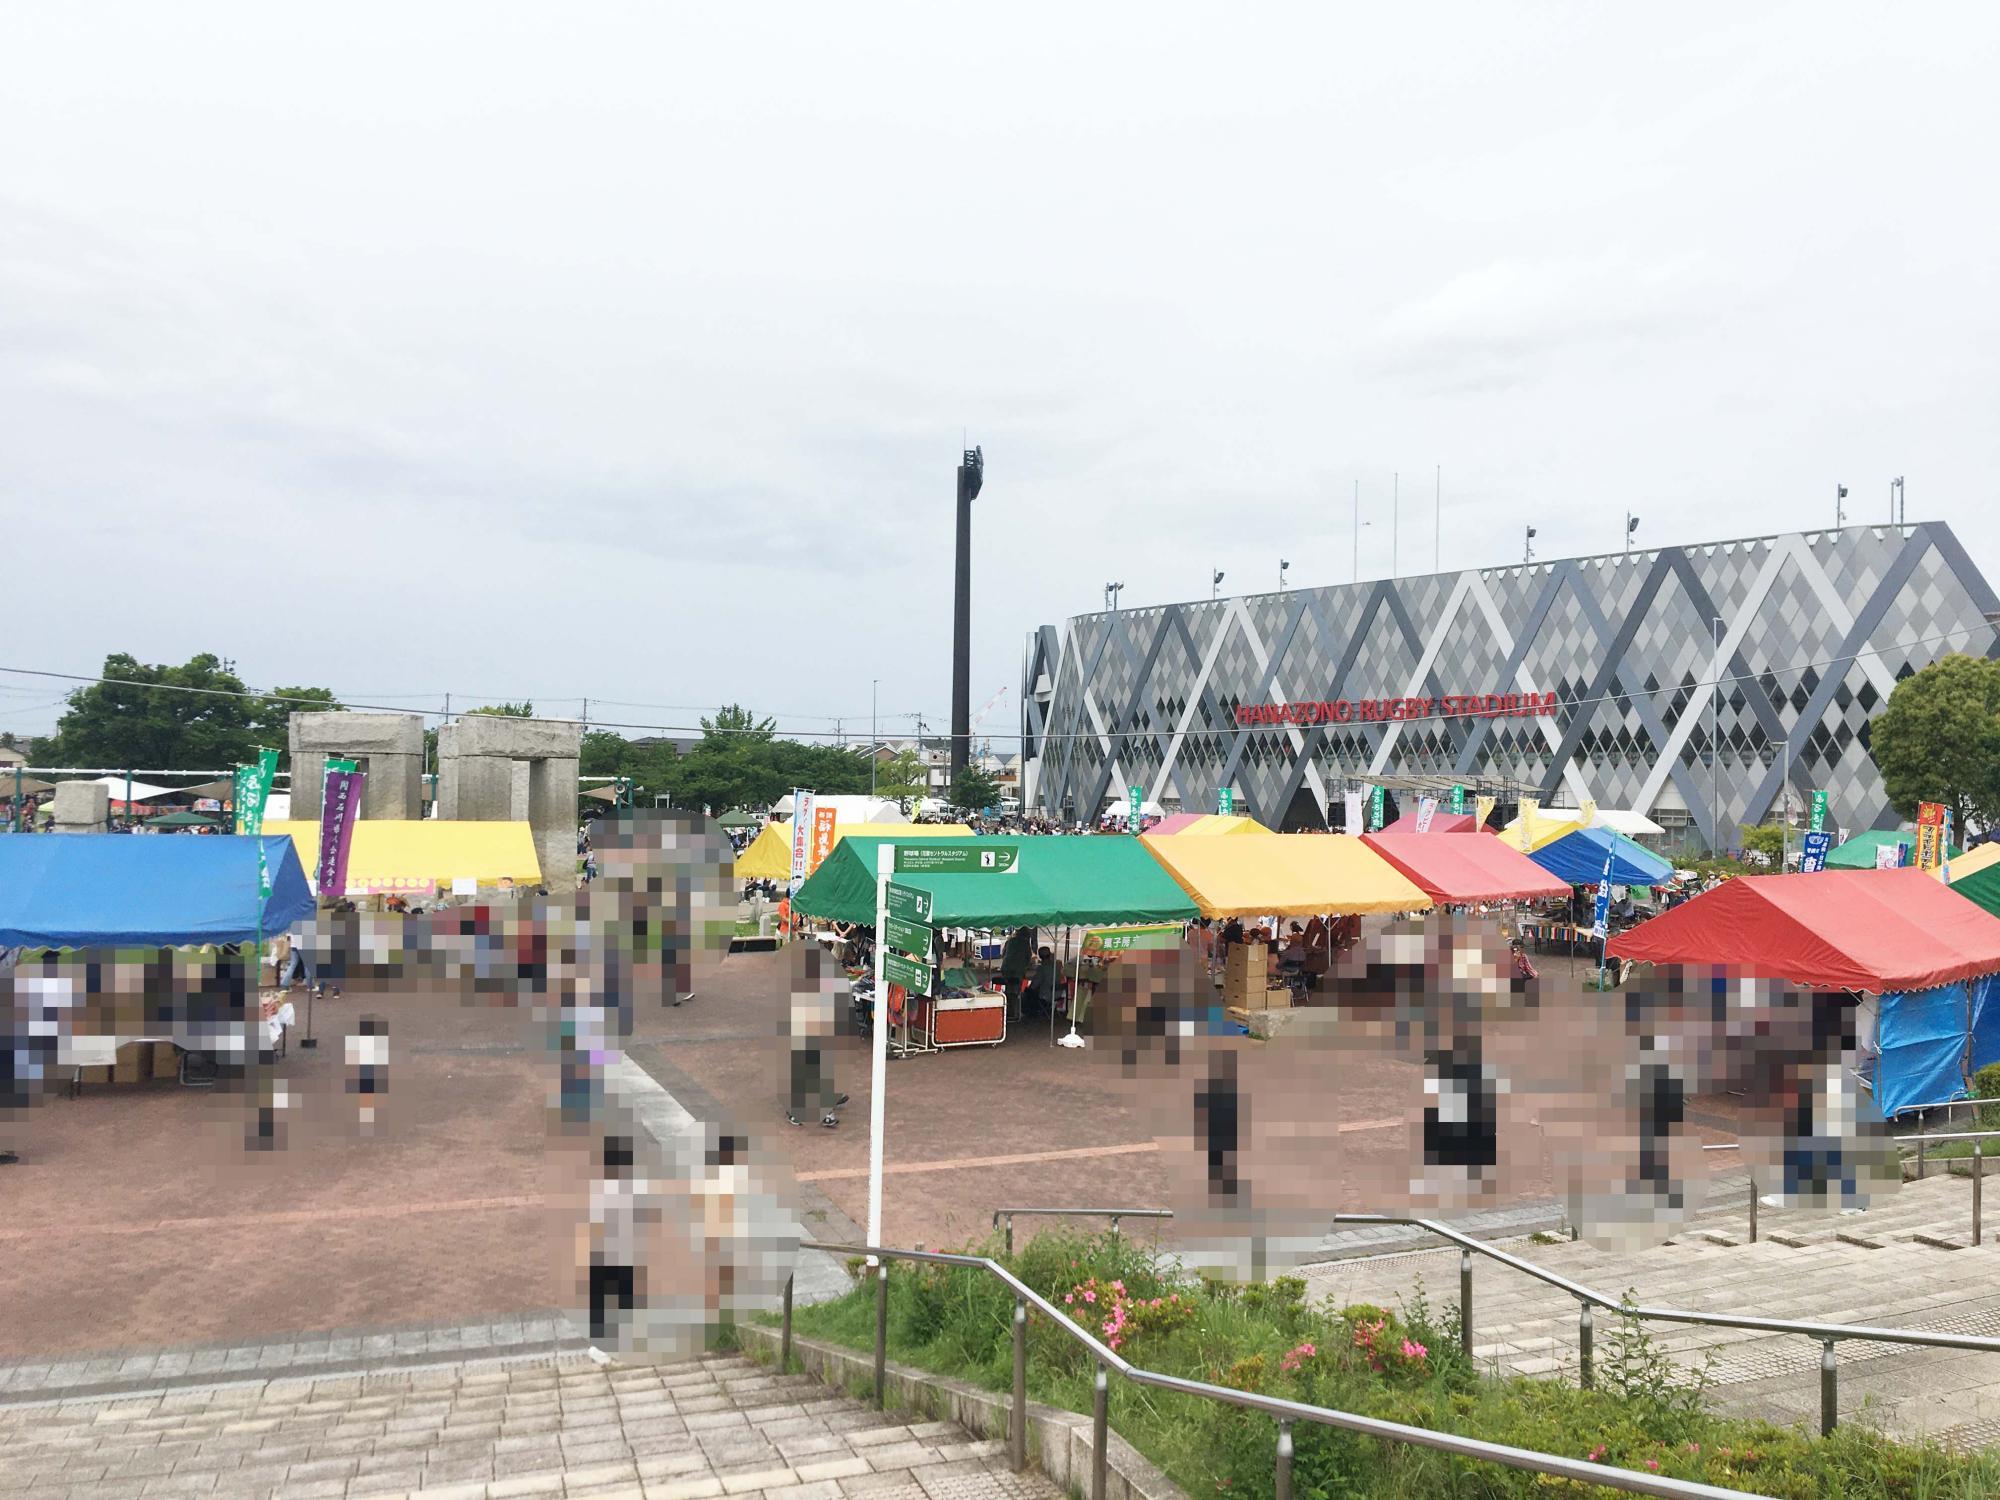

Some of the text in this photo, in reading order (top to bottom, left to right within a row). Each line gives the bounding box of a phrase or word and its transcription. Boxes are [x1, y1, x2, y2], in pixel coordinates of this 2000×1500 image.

[1236, 692, 1557, 725] HANAZONO RUGBY STADIUM
[325, 780, 349, 888] 関西石川県人会連合会
